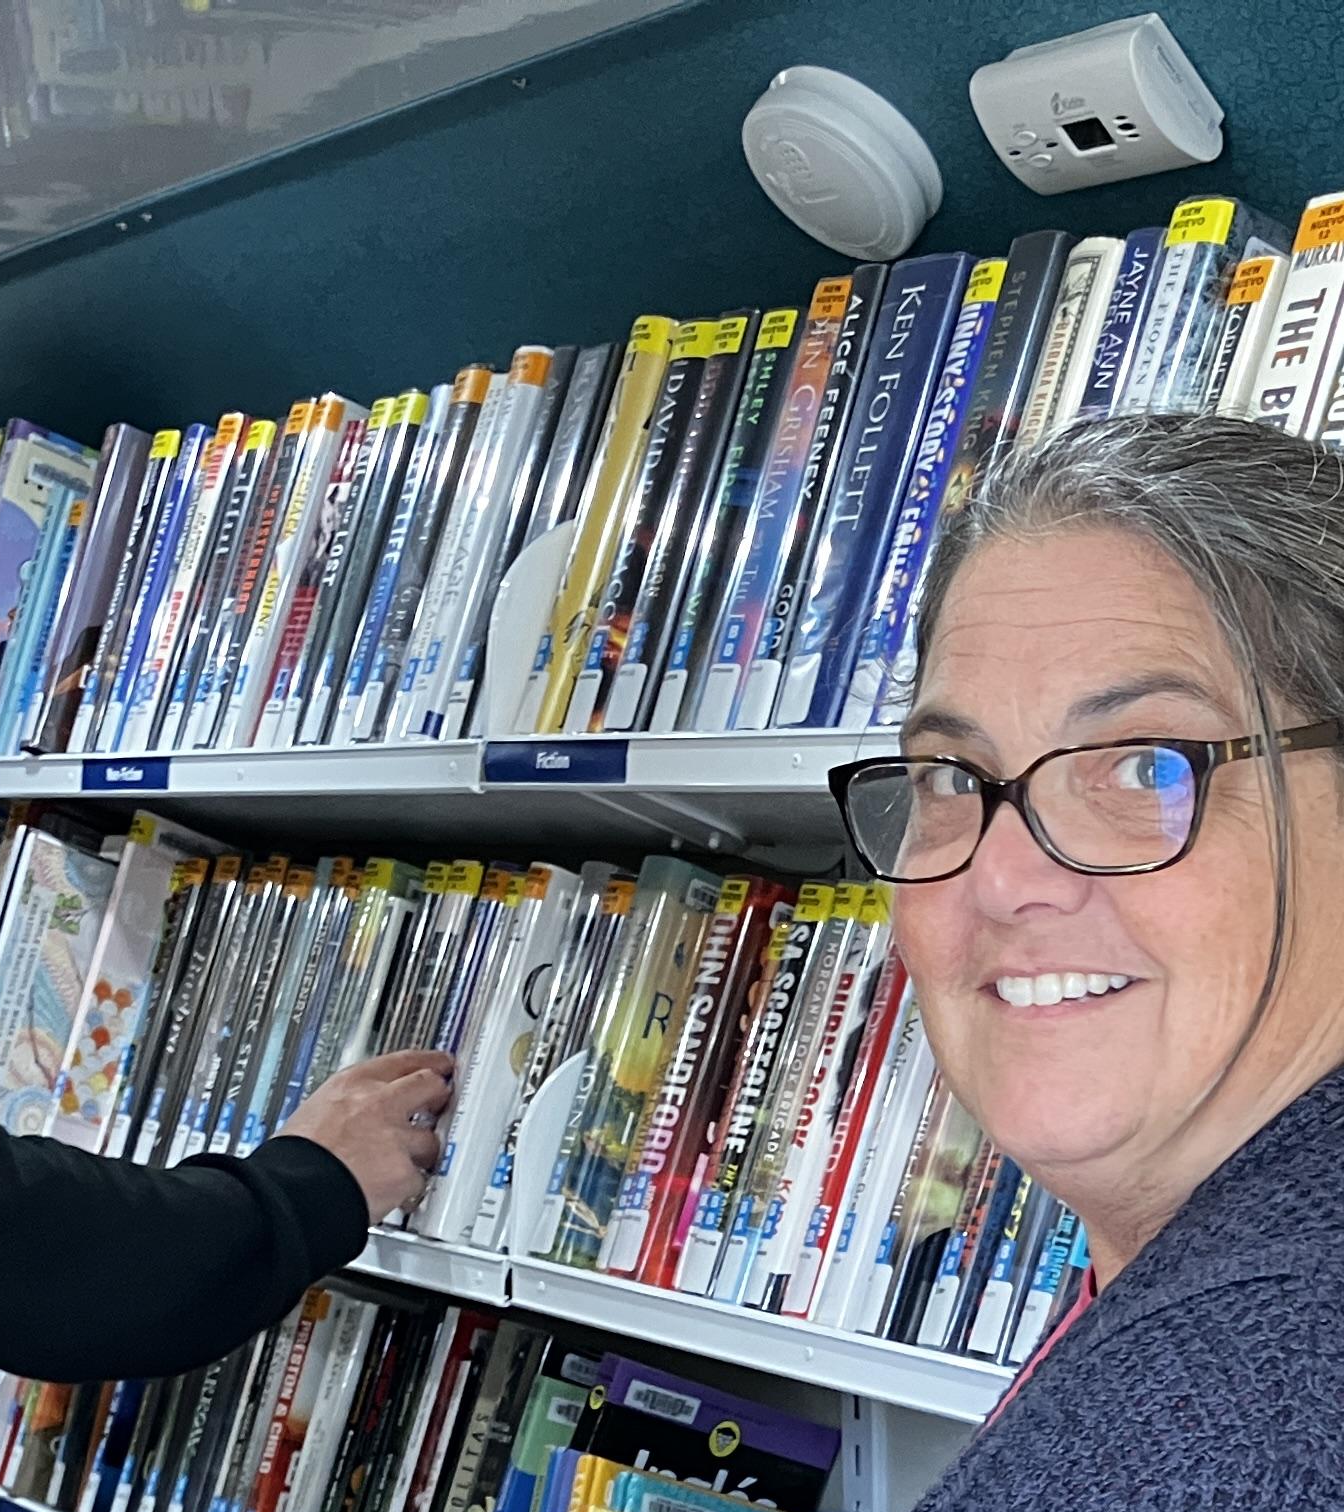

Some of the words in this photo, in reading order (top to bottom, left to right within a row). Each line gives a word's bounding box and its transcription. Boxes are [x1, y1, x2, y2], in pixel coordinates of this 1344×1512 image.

[1171, 218, 1205, 231] NUEVO
[1181, 207, 1202, 217] NEW
[1318, 229, 1331, 240] 12
[1320, 206, 1342, 217] NEW
[1115, 247, 1149, 325] JAYNE
[1240, 265, 1261, 276] NEW
[831, 295, 864, 377] ALICE
[884, 283, 927, 360] KEN
[983, 270, 1027, 380] STEPHEN
[1039, 317, 1071, 388] BARBARA
[1135, 303, 1169, 386] FROZEN
[1271, 287, 1328, 369] THE
[747, 352, 778, 426] SHLEY
[1092, 334, 1125, 390] ANN
[643, 373, 686, 469] DAVID
[755, 384, 816, 520] GRISHAM
[800, 388, 840, 498] FEENEY
[834, 372, 900, 532] FOLLETT
[915, 386, 958, 473] STORY
[963, 389, 990, 450] KING
[321, 529, 350, 587] LOST
[381, 511, 412, 572] LIFE
[638, 993, 714, 1174] SANDFORD
[725, 970, 795, 1155] SCOTTOLINE
[762, 1087, 797, 1166] BRIGADE
[279, 1318, 313, 1402] PRESTON
[257, 1420, 284, 1476] CHILD
[273, 1401, 289, 1419] &
